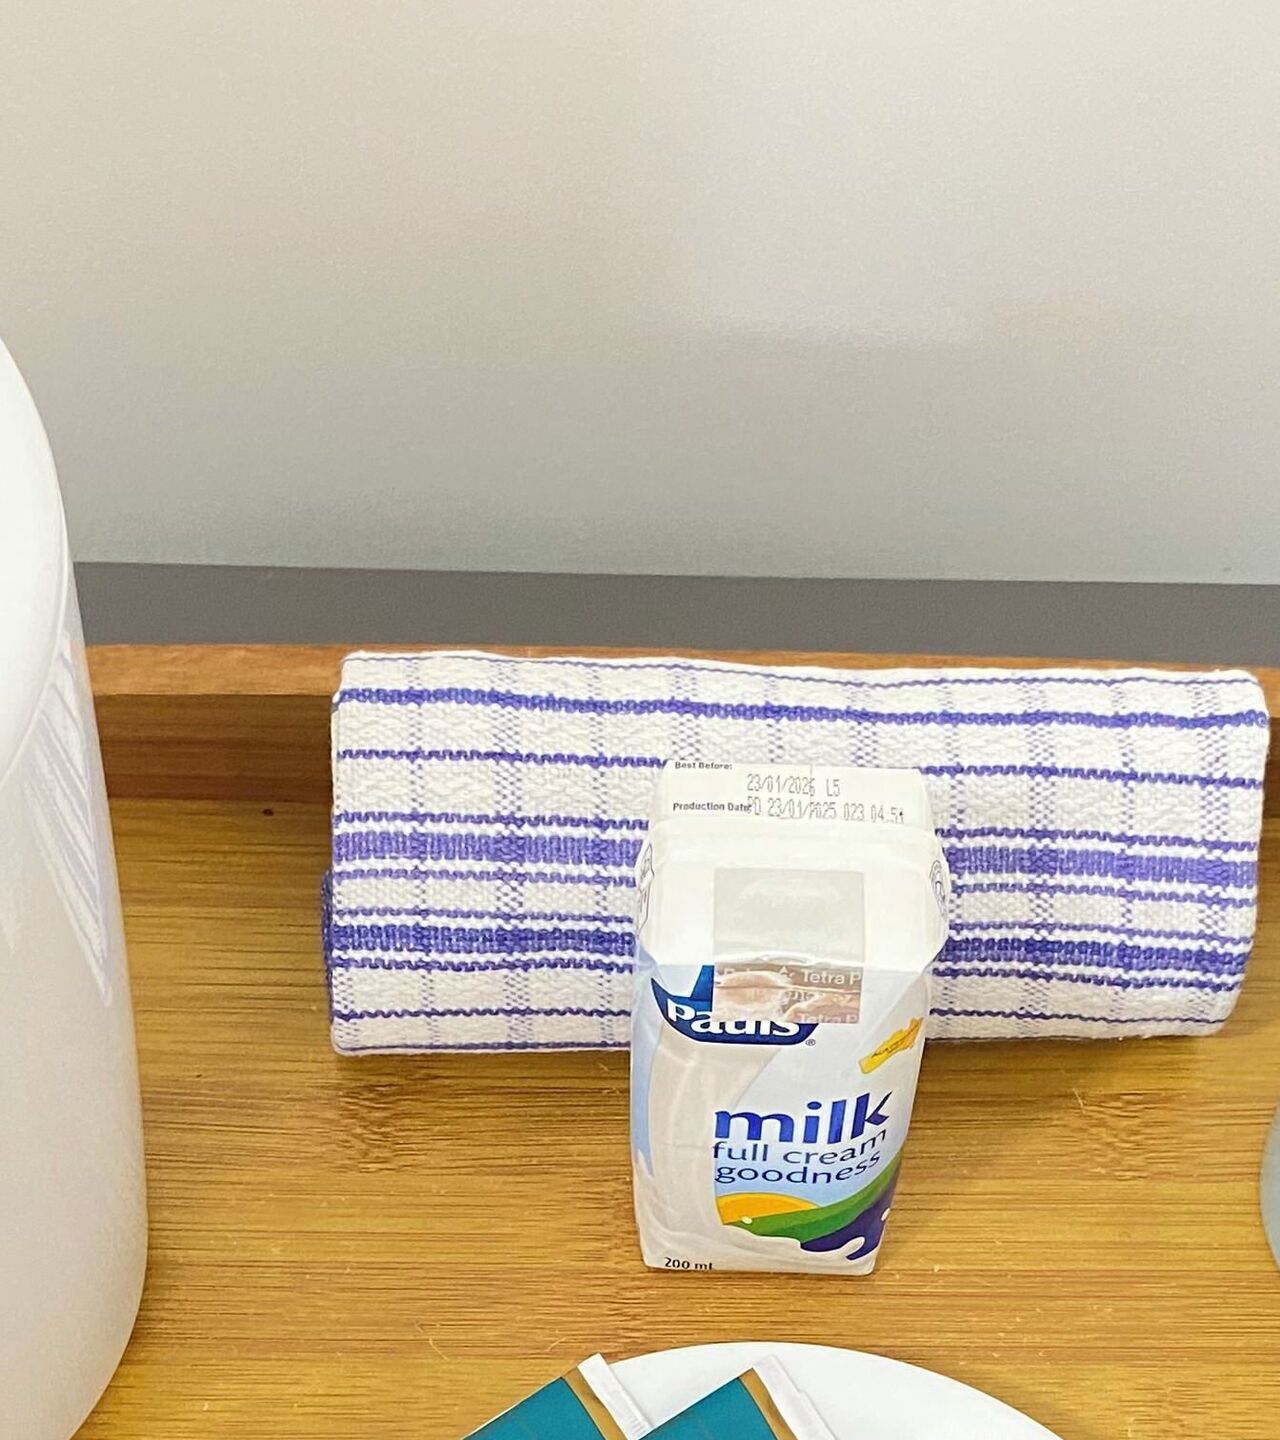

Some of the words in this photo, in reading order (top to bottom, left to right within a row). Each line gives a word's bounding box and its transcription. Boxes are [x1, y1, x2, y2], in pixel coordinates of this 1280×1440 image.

[674, 761, 696, 770] Best
[698, 761, 733, 770] Before:
[672, 802, 726, 812] Production
[801, 968, 846, 985] Tetra
[715, 1091, 893, 1145] milk
[713, 1142, 769, 1163] full
[783, 1130, 887, 1165] cream
[715, 1151, 880, 1184] goodness
[664, 1256, 691, 1270] 200
